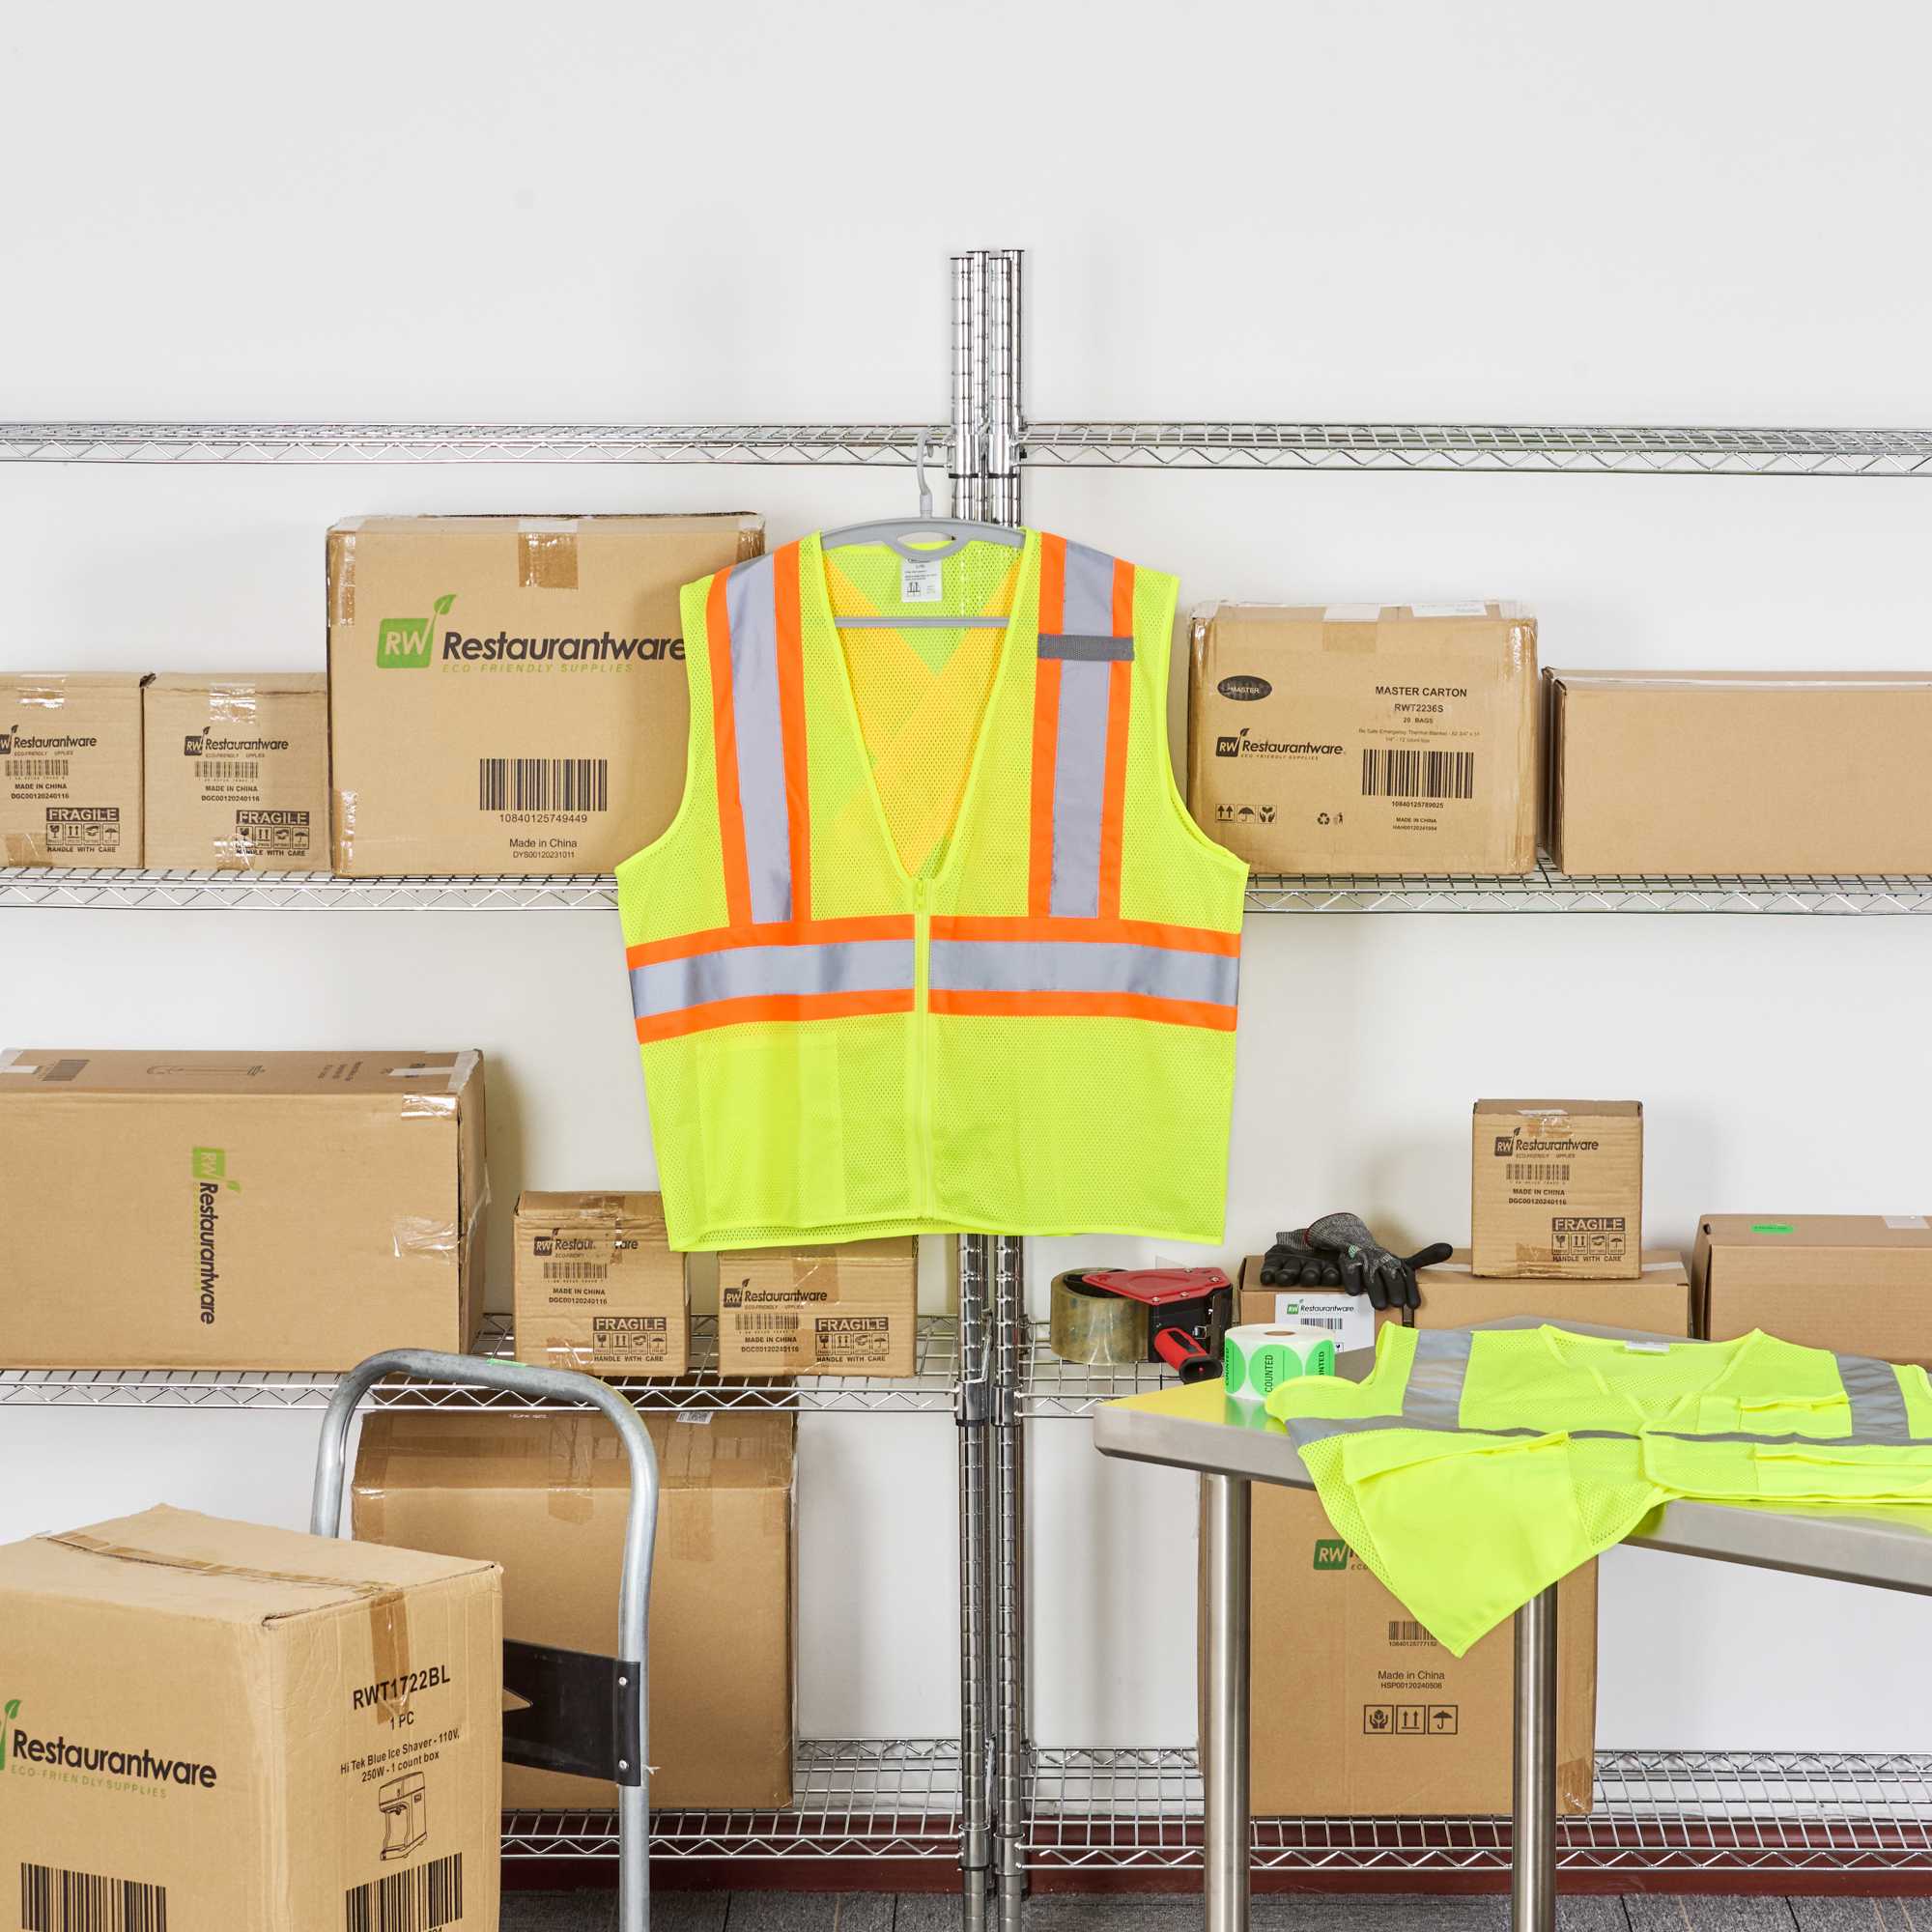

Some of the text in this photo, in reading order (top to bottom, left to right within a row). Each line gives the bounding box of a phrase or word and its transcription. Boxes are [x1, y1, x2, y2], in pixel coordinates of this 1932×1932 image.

[384, 631, 423, 657] RW
[442, 631, 685, 661] Restaurantware
[560, 664, 634, 673] SUPPLIES
[1376, 687, 1467, 696] MASTER CARTON
[1394, 703, 1444, 713] RWT2236S
[14, 736, 97, 749] Restaurantware
[186, 741, 201, 751] RW
[205, 738, 289, 750] Restaurantware
[1219, 741, 1237, 753] RW
[1242, 740, 1343, 755] Restaurantware
[49, 809, 117, 820] FRAGILE
[240, 811, 307, 824] FRAGILE
[500, 813, 587, 823] 10840125749449
[509, 838, 578, 847] Made in China
[1497, 1142, 1512, 1152] RW
[1516, 1139, 1599, 1151] Restaurantware
[1555, 1219, 1624, 1231] FRAGILE
[536, 1241, 552, 1251] RW
[200, 1182, 218, 1324] Restaurantware
[726, 1293, 742, 1302] RW
[745, 1290, 827, 1302] Restaurantware
[595, 1319, 665, 1330] FRAGILE
[818, 1319, 887, 1331] FRAGILE
[1264, 1354, 1273, 1392] COUNTED
[1319, 1547, 1347, 1562] RW
[1378, 1670, 1445, 1679] Made in China
[353, 1664, 450, 1710] RWT1722BL
[390, 1711, 414, 1730] 1 PC
[13, 1729, 217, 1788] Restaurantware
[340, 1763, 350, 1775] Hi
[352, 1757, 366, 1771] Tek
[367, 1752, 386, 1766] Blue
[388, 1747, 401, 1760] Ice
[402, 1738, 432, 1754] Shaver
[362, 1767, 384, 1782] 250W
[391, 1763, 395, 1773] 1
[397, 1754, 422, 1771] count
[423, 1750, 440, 1763] box
[11, 1765, 167, 1799] ECO-FRIENDLY SUPPLIES
